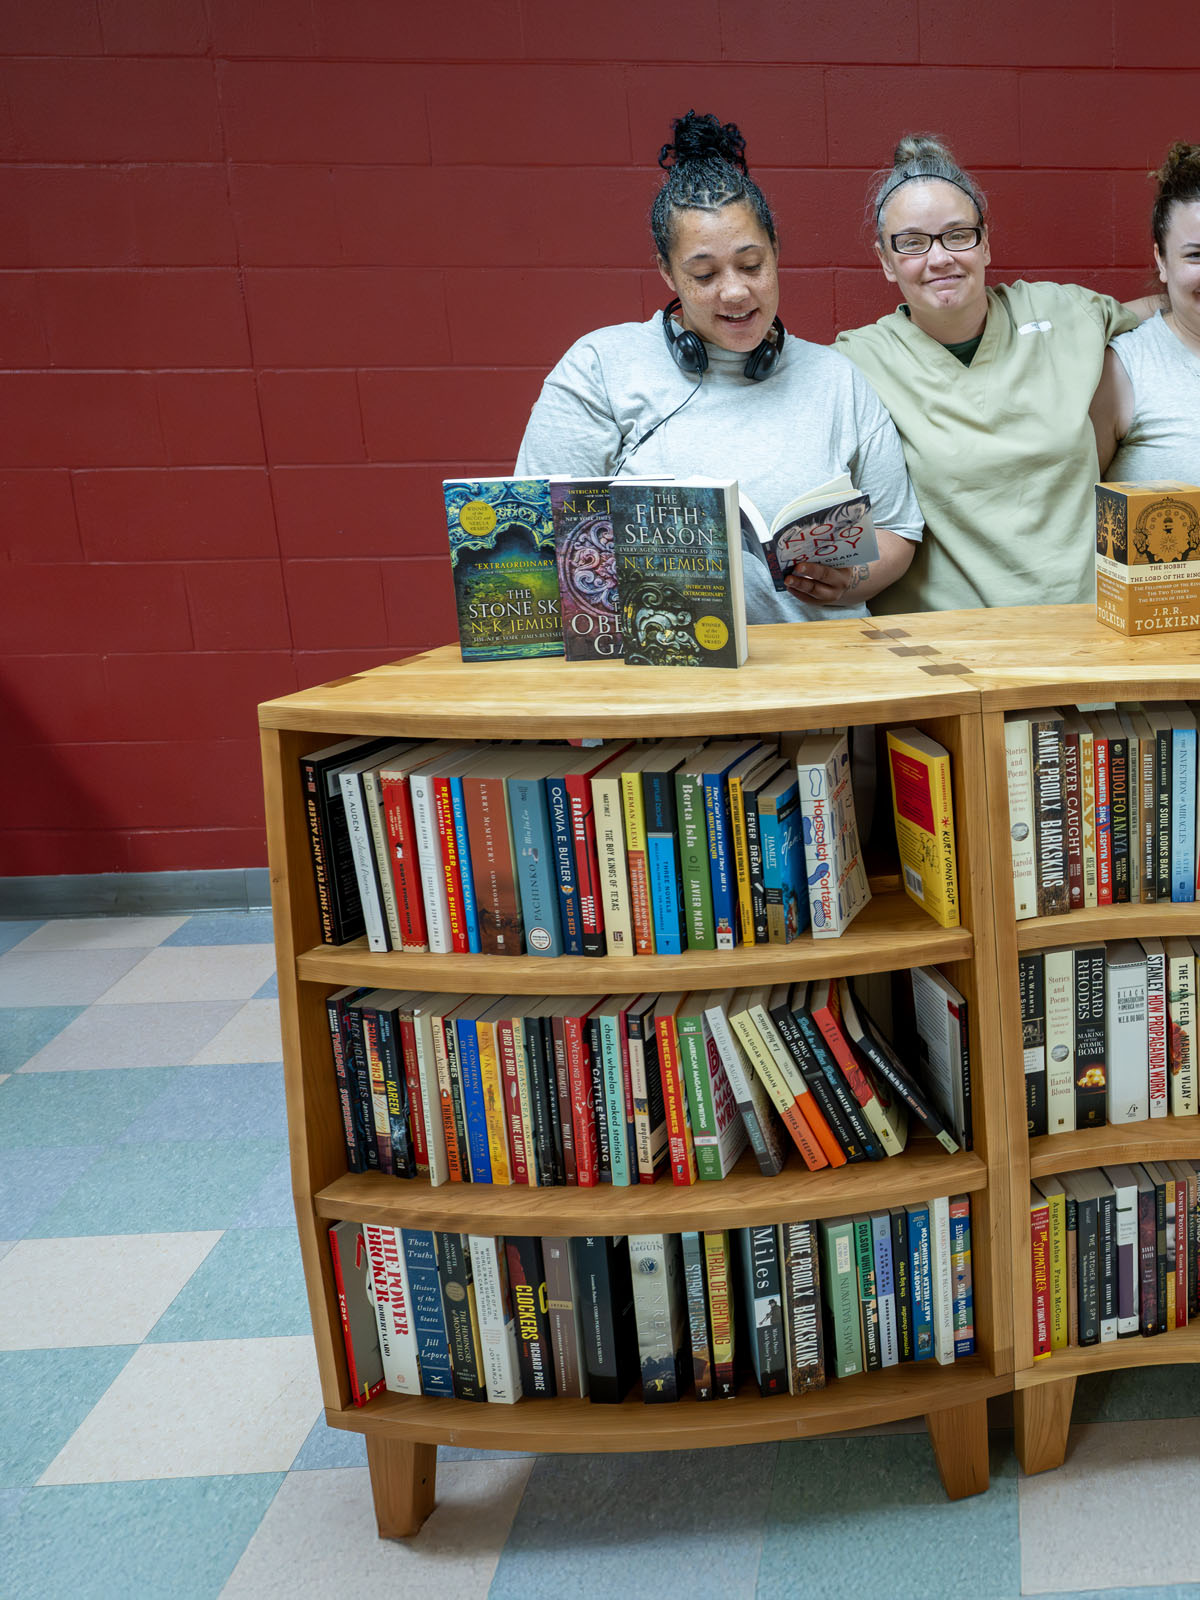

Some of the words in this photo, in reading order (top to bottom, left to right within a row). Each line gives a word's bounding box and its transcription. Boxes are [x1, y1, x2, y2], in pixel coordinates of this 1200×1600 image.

[636, 504, 699, 525] FIFTH
[655, 494, 678, 505] THE
[625, 524, 714, 546] SEASON
[784, 523, 833, 550] NO
[624, 557, 641, 570] N.
[645, 557, 659, 570] K.
[663, 557, 723, 572] JEMISIN
[825, 553, 859, 563] OKADA
[469, 601, 533, 619] STONE
[538, 600, 560, 614] SK
[506, 589, 532, 600] THE
[472, 622, 488, 634] N.
[493, 620, 506, 633] K.
[1098, 607, 1126, 630] TOLKIEN
[1135, 615, 1200, 631] TOLKIEN
[1153, 607, 1183, 617] J.R.R.
[1038, 730, 1060, 765] ANNIE
[1065, 745, 1078, 796] NEVER
[1112, 758, 1126, 813] RUDOLFO
[682, 784, 697, 821] Berta
[1039, 768, 1062, 811] PROULX
[1082, 739, 1095, 853] HEAVY
[1160, 794, 1169, 806] MY
[441, 786, 452, 825] REALITY
[453, 797, 462, 818] SUM
[551, 787, 566, 832] OCTAVIA
[572, 797, 585, 841] ERASURE
[1160, 808, 1168, 829] SOUL
[456, 826, 466, 855] DAVID
[558, 836, 567, 845] E.
[685, 824, 696, 847] Isla
[812, 799, 830, 861] Hopscotch
[1067, 797, 1080, 856] CAUGHT
[1113, 816, 1127, 855] ANAYA
[445, 829, 456, 866] HUNGER
[942, 830, 953, 854] KURT
[1040, 820, 1064, 888] BARKSKINS
[1159, 831, 1169, 857] LOOKS
[444, 865, 454, 893] DAVID
[559, 847, 571, 881] BUTLER
[1160, 858, 1169, 879] BACK
[459, 860, 472, 911] EAGLEMAN
[819, 870, 833, 920] Cortázar
[944, 857, 956, 905] VONNEGUT
[448, 897, 458, 934] SHIELDS
[1078, 959, 1090, 1020] RHODES
[1092, 957, 1103, 1018] RICHARD
[1147, 956, 1163, 993] STANLEY
[1149, 994, 1164, 1013] HOW
[502, 1028, 513, 1046] BIRD
[604, 1023, 617, 1055] charles
[659, 1020, 668, 1037] WE
[1149, 1015, 1165, 1069] PROPAGANDA
[504, 1048, 514, 1058] BY
[505, 1059, 516, 1076] BIRD
[662, 1038, 672, 1068] NEED
[607, 1057, 620, 1095] wheelan
[665, 1070, 675, 1094] NEW
[1150, 1070, 1165, 1100] WORKS
[386, 1080, 400, 1115] KAREEM
[443, 1104, 453, 1129] THINGS
[511, 1114, 521, 1134] ANNE
[610, 1100, 620, 1126] naked
[668, 1095, 679, 1134] NAMES
[446, 1132, 456, 1149] FALL
[513, 1135, 525, 1163] LAMOTT
[612, 1129, 623, 1164] statistics
[448, 1150, 458, 1172] APART
[1052, 1201, 1062, 1237] Angela's
[381, 1226, 399, 1269] THE
[789, 1223, 813, 1257] ANNIE
[1053, 1239, 1062, 1264] Ashes
[366, 1226, 391, 1303] BROKER
[708, 1251, 727, 1280] TRAIL
[753, 1226, 775, 1289] Miles
[1033, 1241, 1047, 1293] SYMPATHIZER
[711, 1281, 727, 1293] OF
[791, 1258, 814, 1299] PROULX
[1054, 1269, 1062, 1295] Frank
[388, 1272, 409, 1336] POWER
[515, 1284, 539, 1340] CLOCKERS
[1054, 1297, 1063, 1331] McCourt
[711, 1295, 731, 1345] LIGHTNING
[793, 1304, 819, 1368] BARKSKINS
[530, 1342, 542, 1370] RICHARD
[533, 1372, 545, 1390] PRICE
